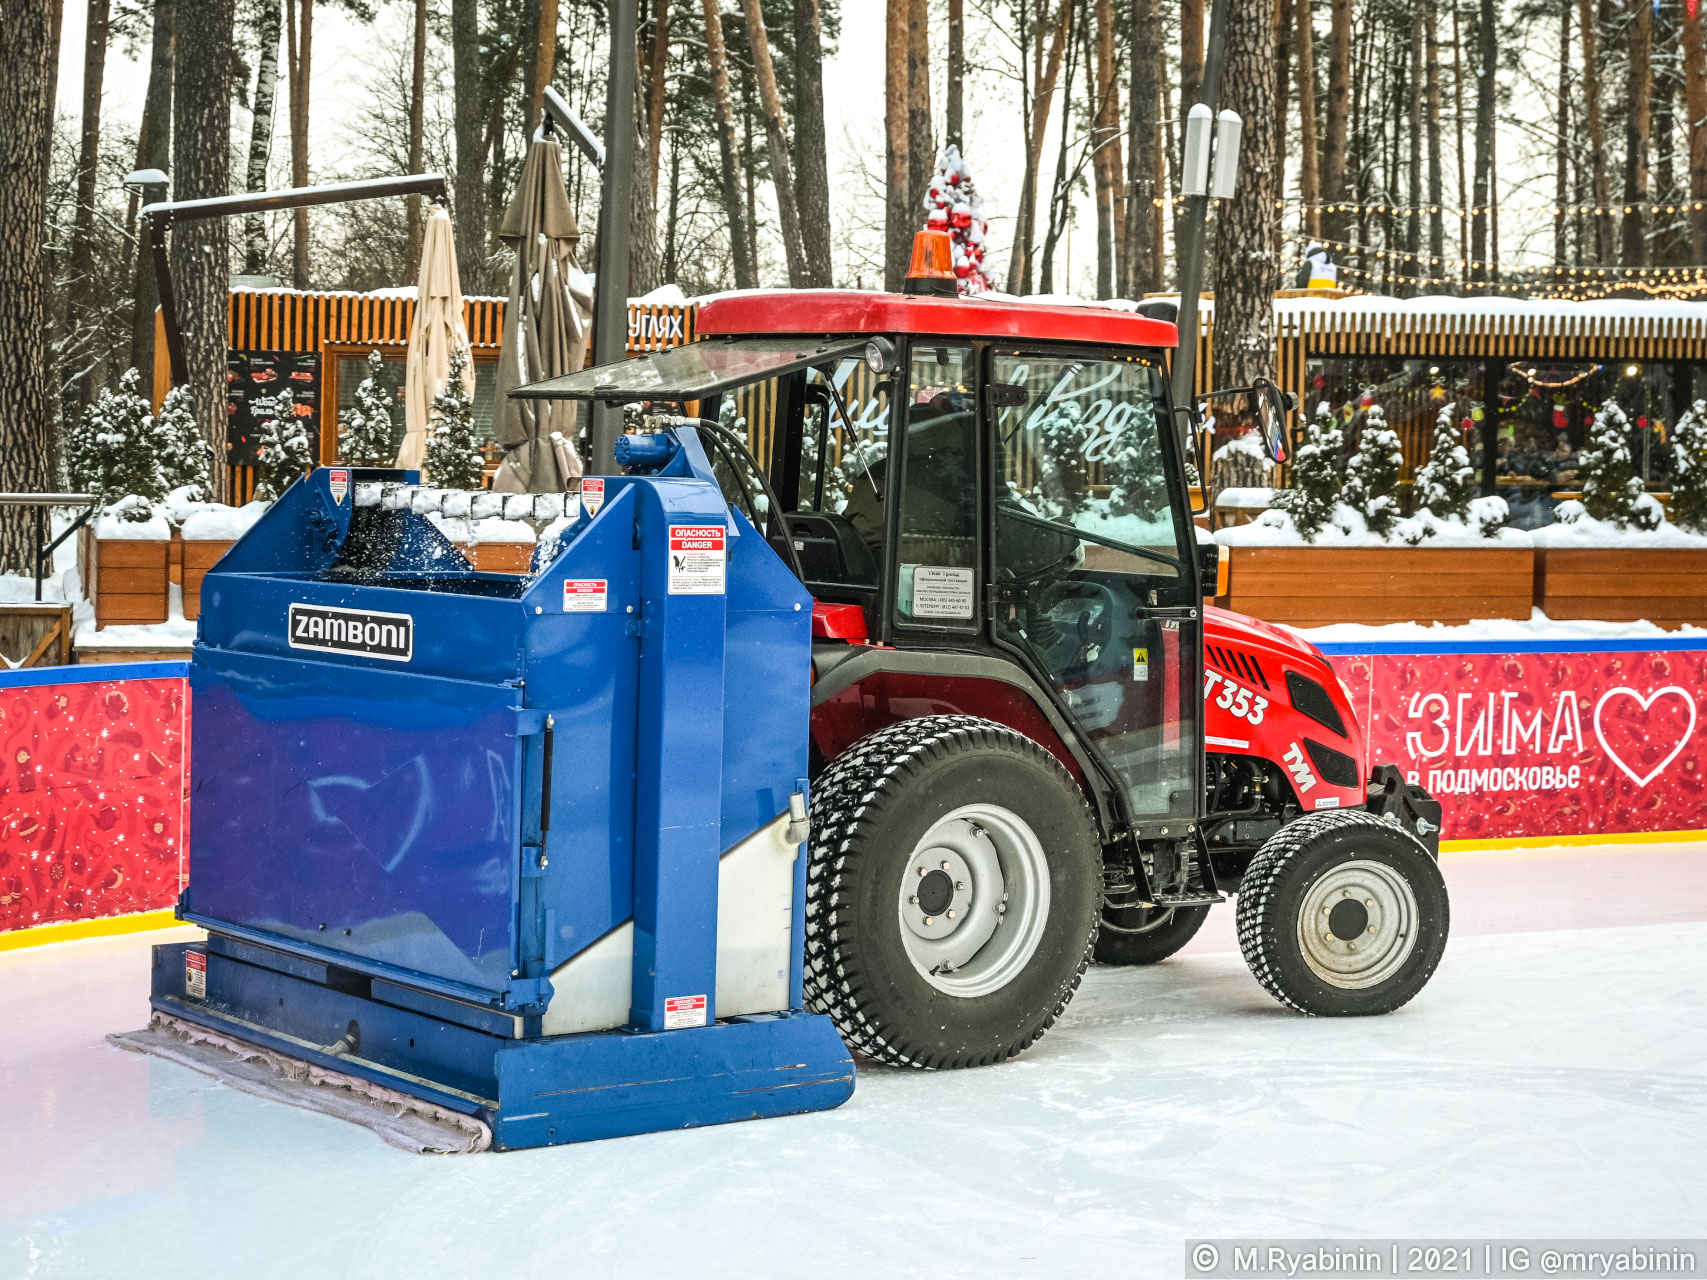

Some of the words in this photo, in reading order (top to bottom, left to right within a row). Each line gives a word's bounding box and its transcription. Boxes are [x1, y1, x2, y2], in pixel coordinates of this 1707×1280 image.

[628, 310, 683, 338] УГЛЯХ
[675, 529, 721, 537] ОПАСНОСТЬ
[681, 541, 713, 549] DANGER
[295, 615, 405, 648] ZAMBONI
[1204, 668, 1269, 725] T353
[1406, 691, 1583, 760] ЗИМА
[1282, 742, 1317, 793] TYM
